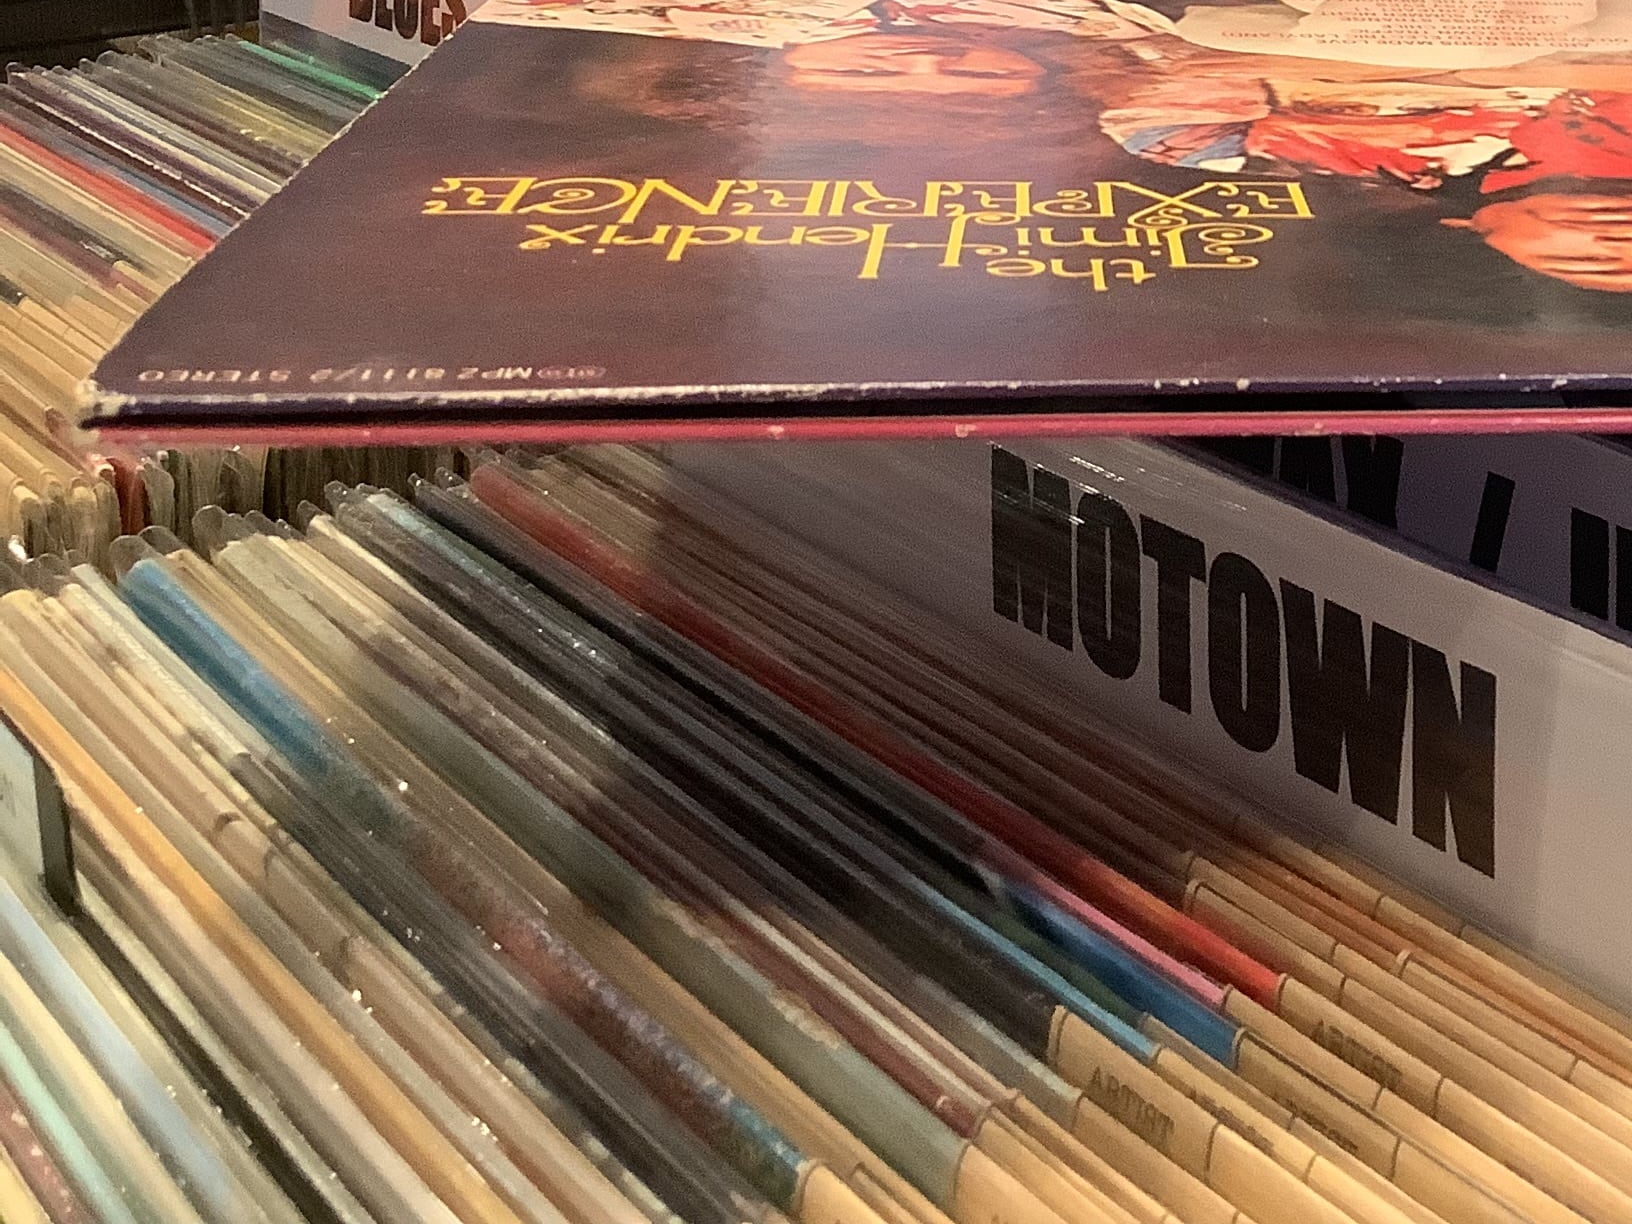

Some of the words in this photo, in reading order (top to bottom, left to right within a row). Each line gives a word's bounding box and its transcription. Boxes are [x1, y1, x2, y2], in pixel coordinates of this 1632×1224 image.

[420, 176, 1315, 224] EXPERIENCE
[516, 212, 1010, 279] Hendrix
[1012, 221, 1274, 270] Jimi
[986, 258, 1157, 292] the
[138, 370, 291, 382] STEREO
[1469, 471, 1516, 573] /
[990, 444, 1498, 879] MOTOWN
